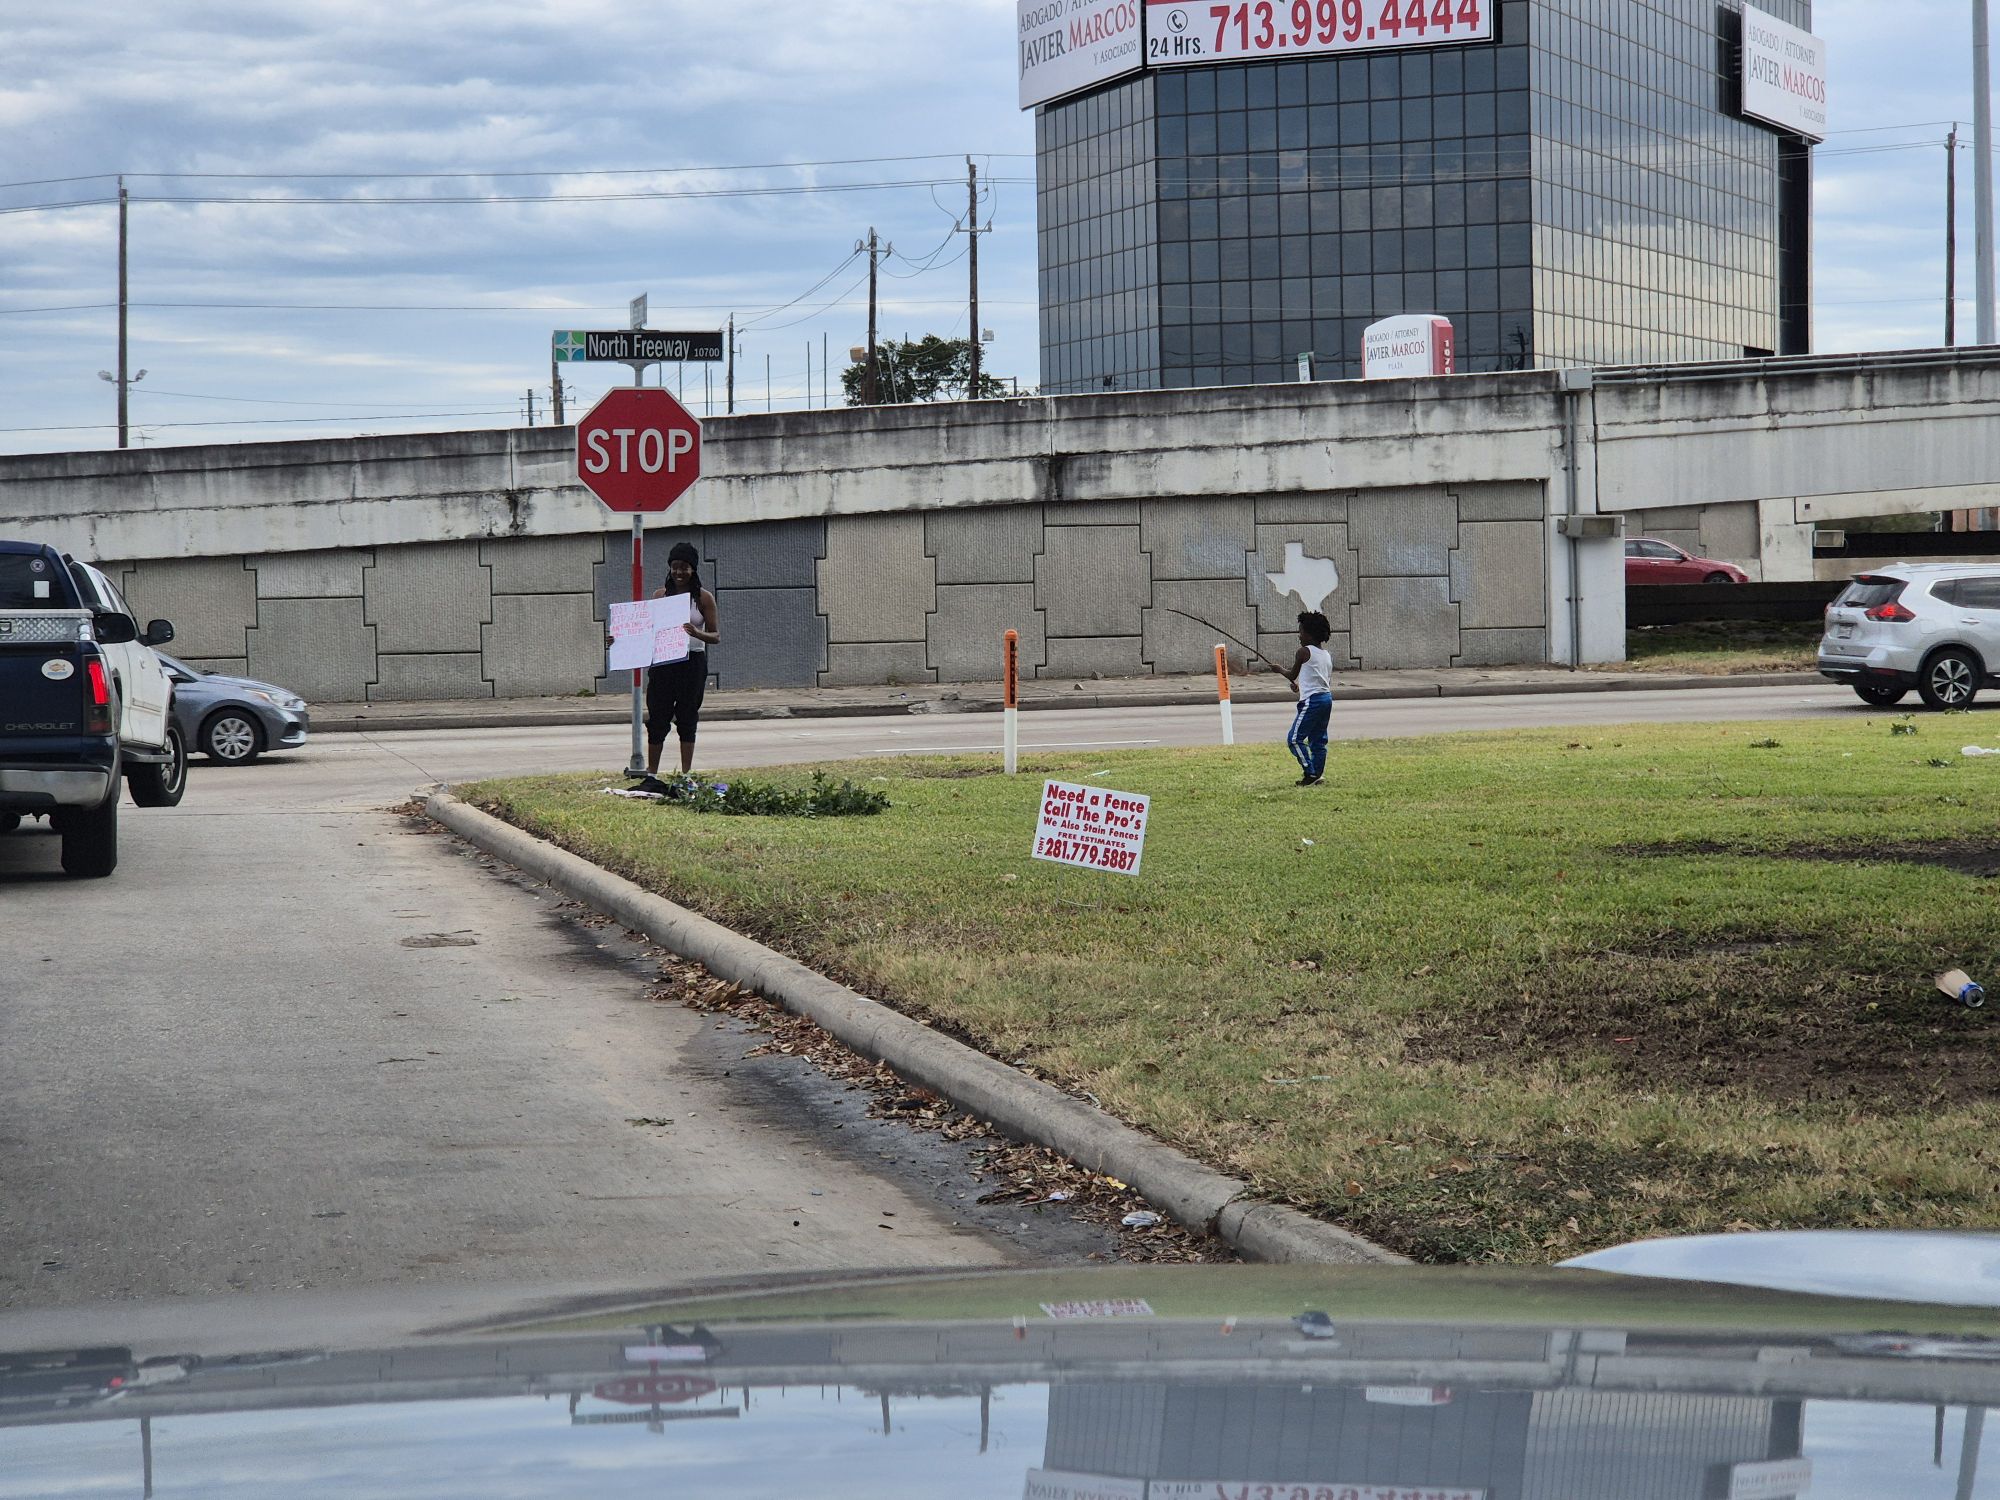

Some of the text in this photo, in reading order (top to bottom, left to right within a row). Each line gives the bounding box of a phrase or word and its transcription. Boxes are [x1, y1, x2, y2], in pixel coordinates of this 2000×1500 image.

[1020, 1, 1063, 33] ABOGADO
[1210, 0, 1480, 53] 713.999.4444
[1021, 0, 1136, 80] JAVIER MARCOS
[1100, 39, 1137, 64] ASOCIADOS
[1150, 36, 1206, 58] 24 Hrs.
[1748, 24, 1779, 52] ABOGADO
[1785, 41, 1816, 66] ATTORNEY
[1748, 47, 1825, 104] JAVIER MARCOS
[588, 333, 720, 361] North Freeway 10700
[1367, 332, 1390, 343] ABOGADO
[1395, 328, 1419, 339] ATTORNEY
[1366, 341, 1425, 365] JAVIER MARCOS
[585, 428, 693, 474] STOP
[5, 722, 76, 731] CHEVROLET
[1047, 784, 1145, 813] Need a Fence
[1043, 816, 1139, 841] We Also Stain Fences
[1044, 800, 1142, 830] Call The Pro's
[1044, 837, 1137, 871] 281.779.5887
[1058, 832, 1126, 848] FREE ESTIMATES
